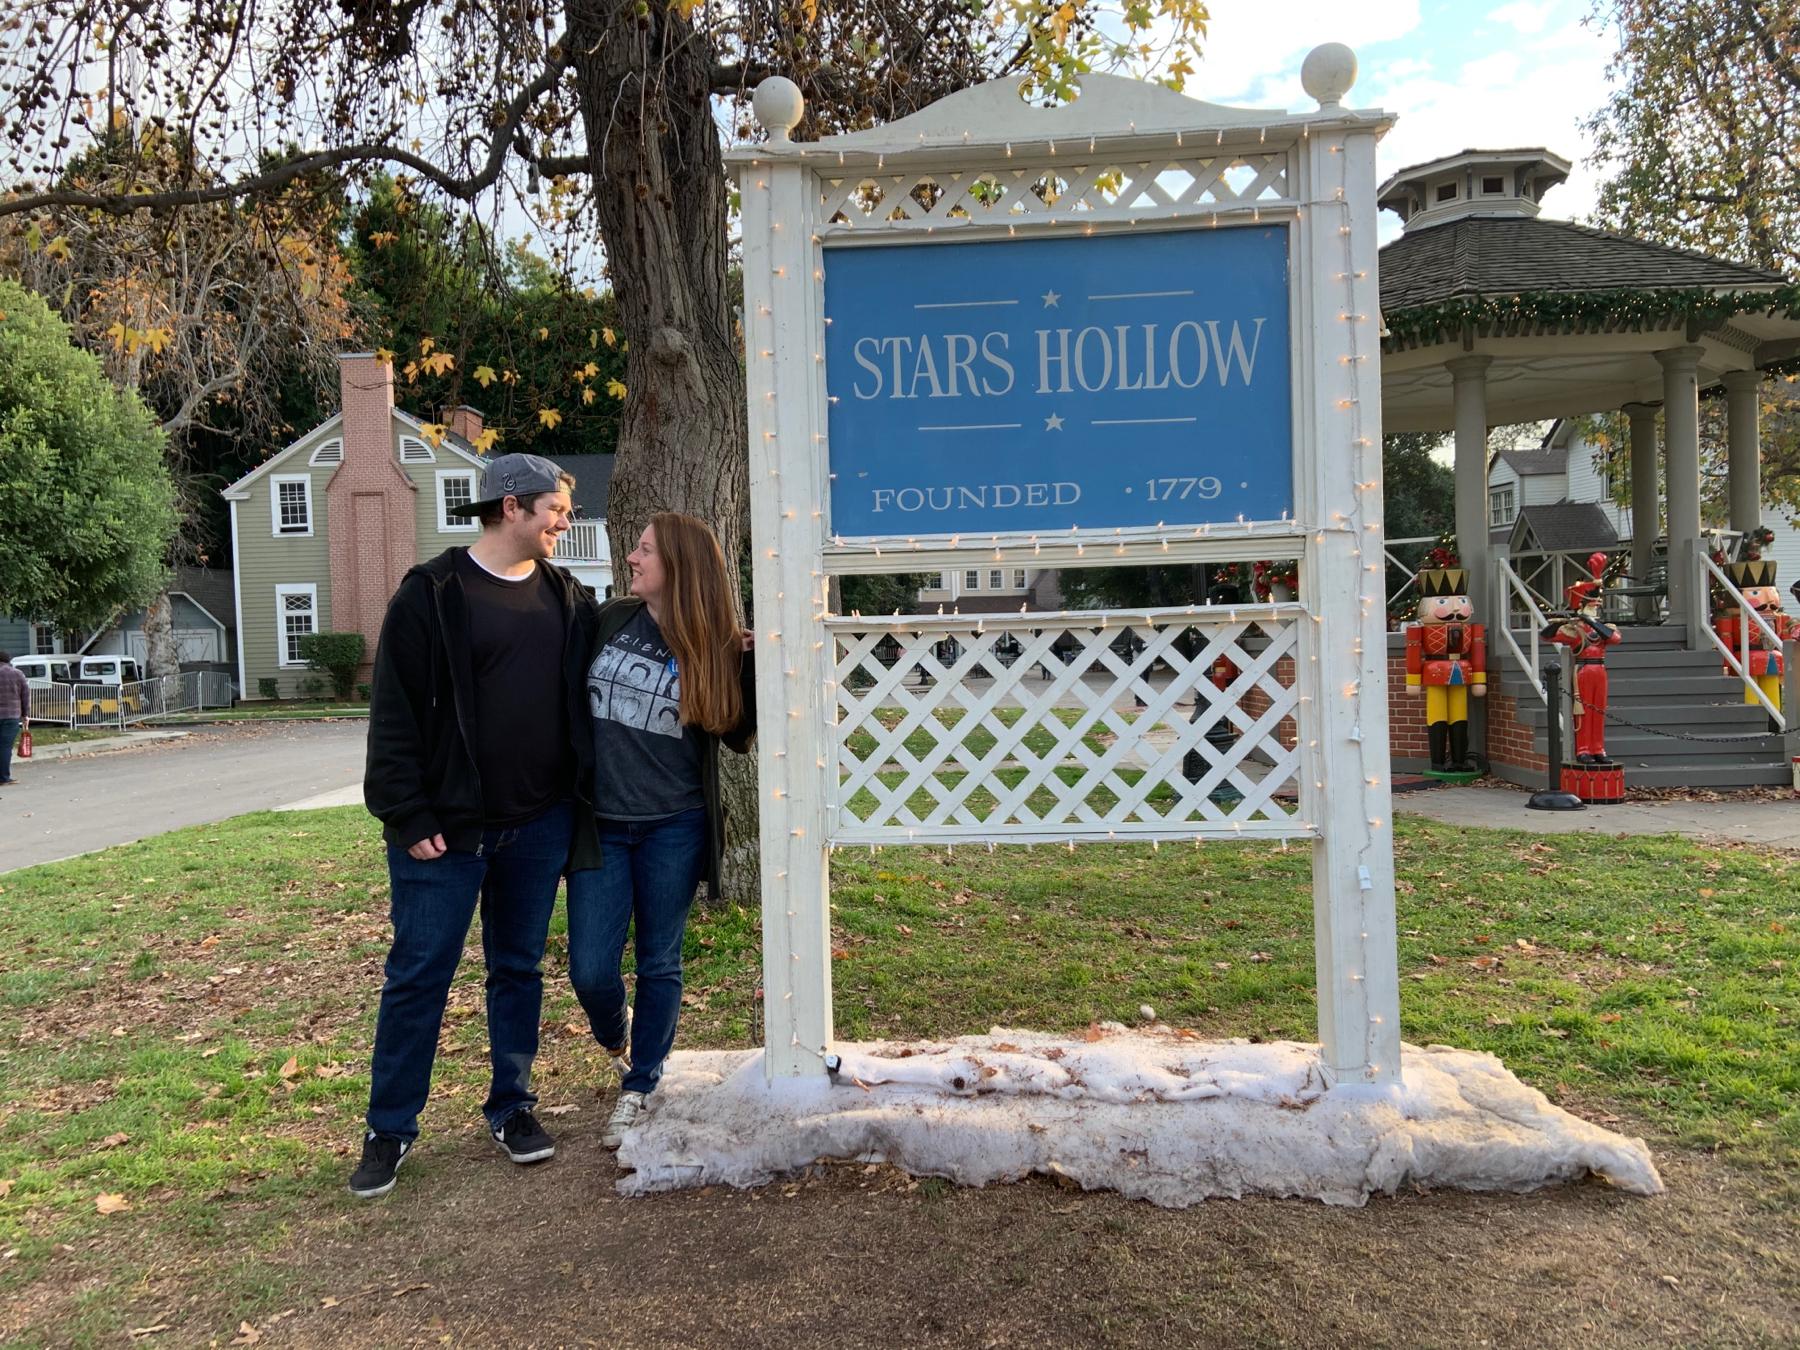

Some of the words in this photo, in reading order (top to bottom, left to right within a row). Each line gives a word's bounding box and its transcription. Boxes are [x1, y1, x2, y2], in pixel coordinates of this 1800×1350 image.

[853, 331, 1015, 400] STARS
[1035, 318, 1266, 394] HOLLOW
[871, 482, 1082, 513] FOUNDED
[1146, 476, 1222, 501] 1779
